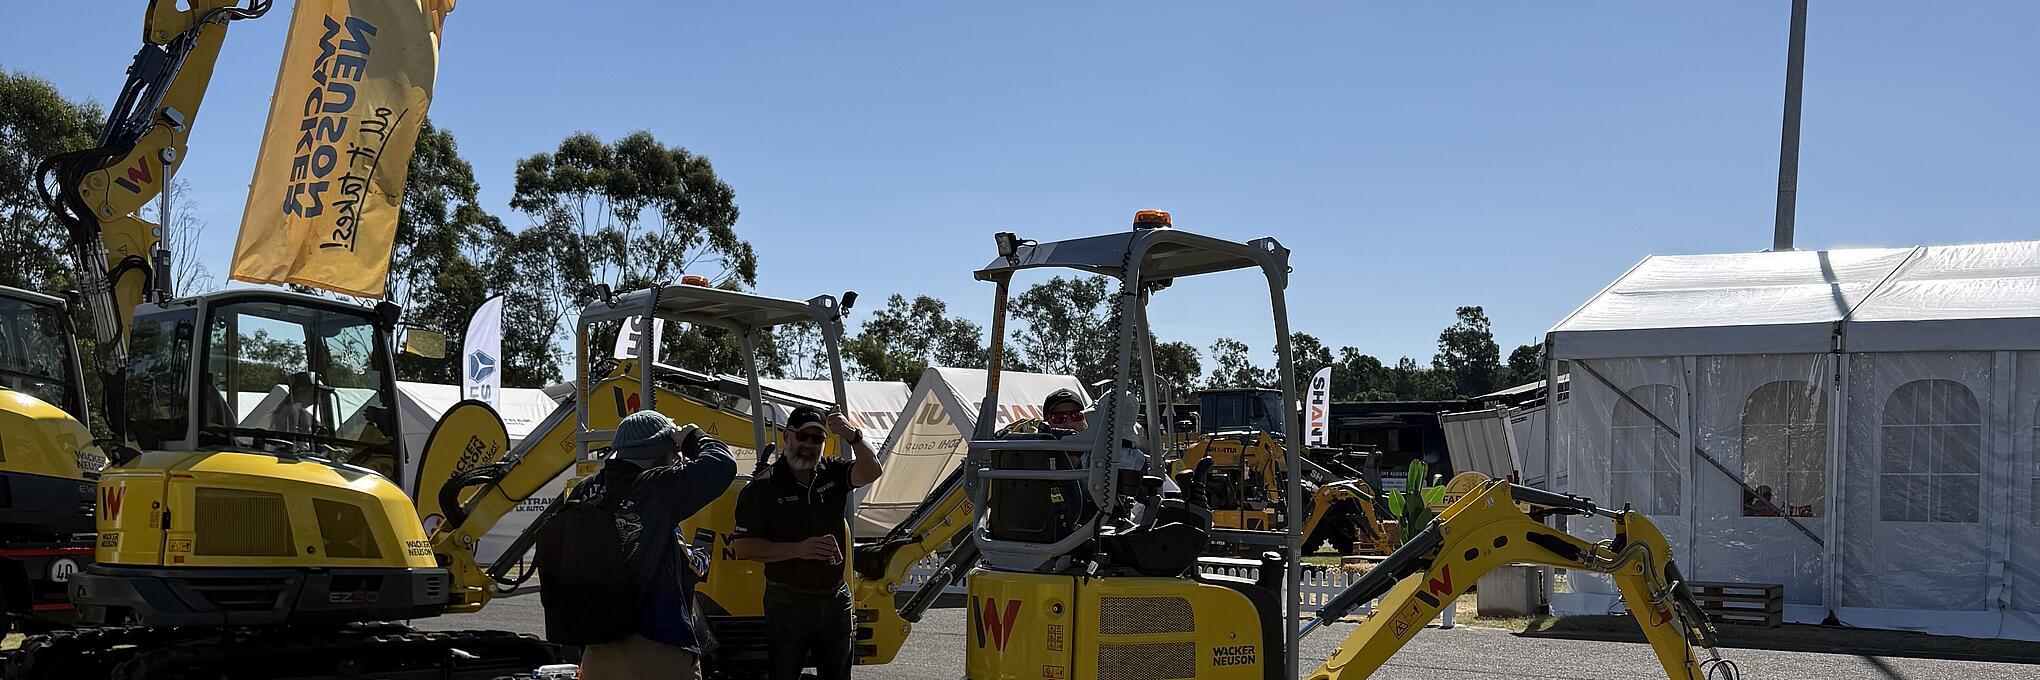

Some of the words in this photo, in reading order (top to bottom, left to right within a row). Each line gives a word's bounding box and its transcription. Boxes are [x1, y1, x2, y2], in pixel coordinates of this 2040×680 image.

[408, 548, 433, 557] NEUSON
[1213, 645, 1256, 657] WACKER
[1213, 655, 1256, 667] NEUSON
